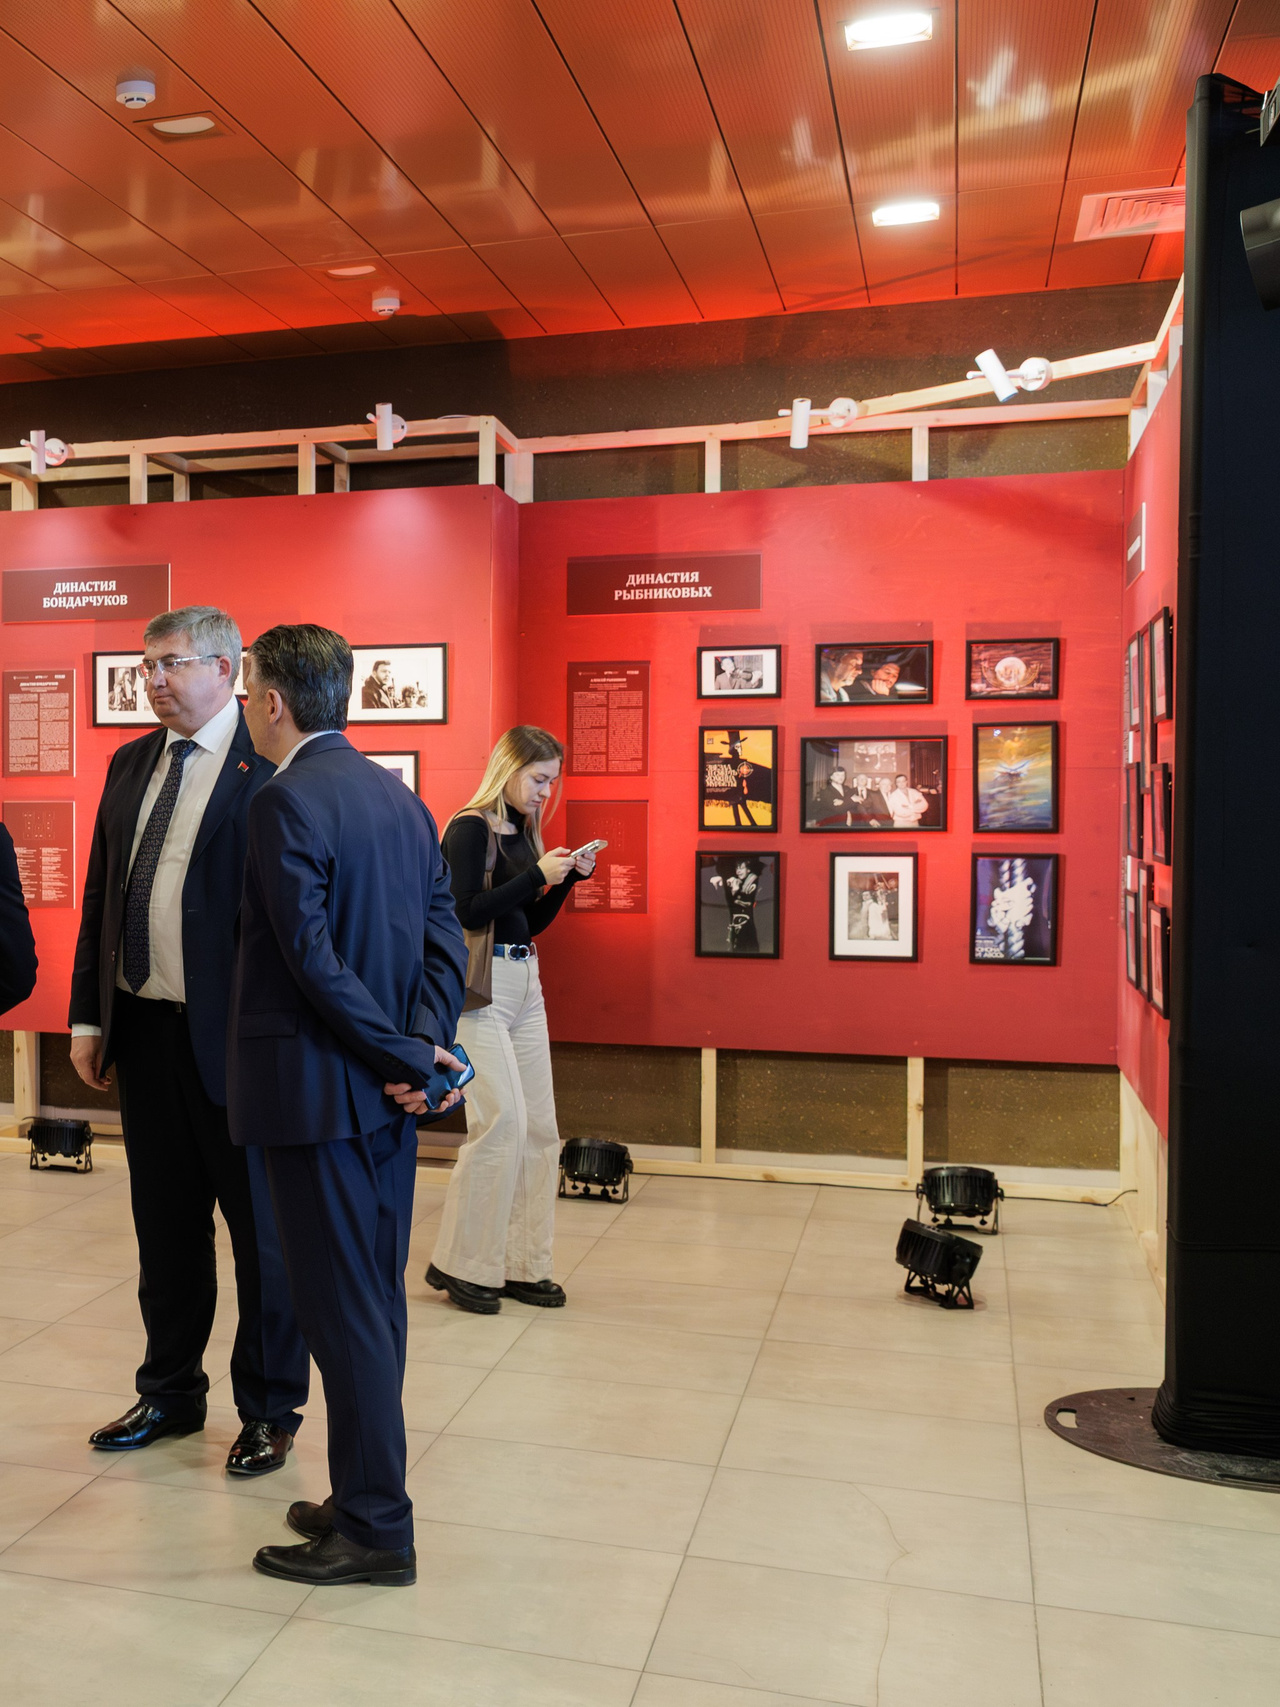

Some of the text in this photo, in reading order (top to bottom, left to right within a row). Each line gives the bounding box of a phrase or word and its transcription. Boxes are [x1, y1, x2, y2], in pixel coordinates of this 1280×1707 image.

[625, 571, 700, 587] ДИНАСТИЯ
[53, 580, 116, 595] ДИНАСТИЯ
[614, 586, 713, 601] РЫБНИКОВЫХ
[42, 594, 128, 609] БОНДАРЧУКОВ
